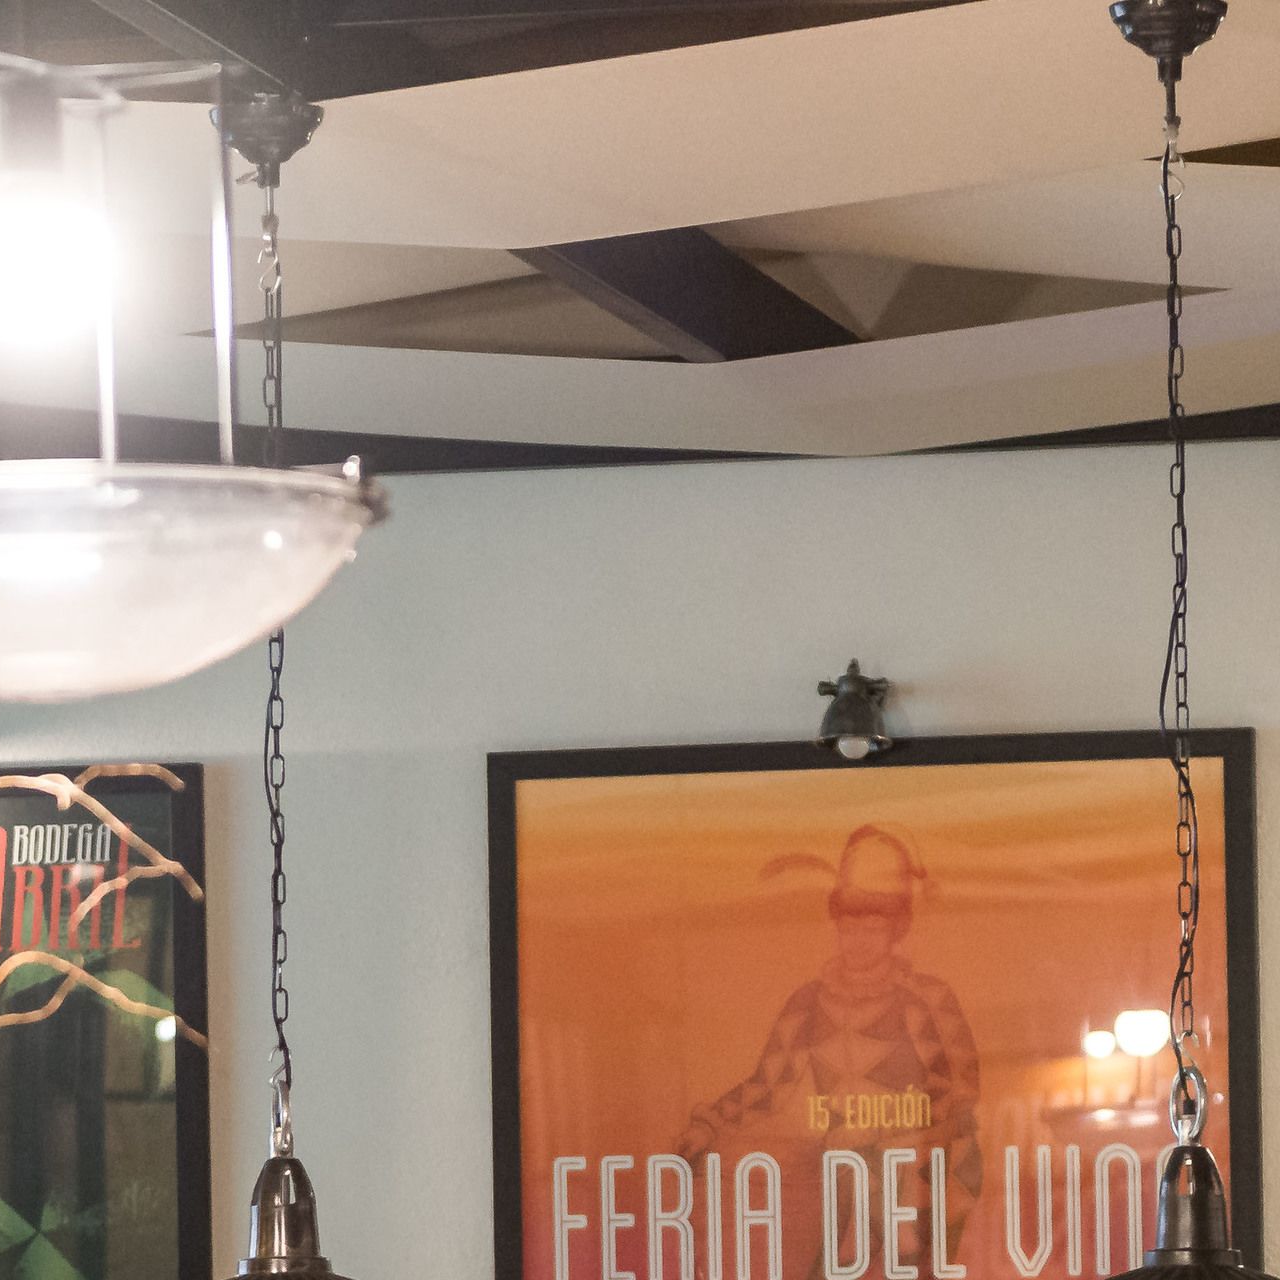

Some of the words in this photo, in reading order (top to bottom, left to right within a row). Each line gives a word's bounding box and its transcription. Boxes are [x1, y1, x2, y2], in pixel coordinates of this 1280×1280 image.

[12, 823, 113, 866] BODEGA
[845, 1084, 932, 1130] EDICIÓN
[1005, 1143, 1191, 1277] VIN
